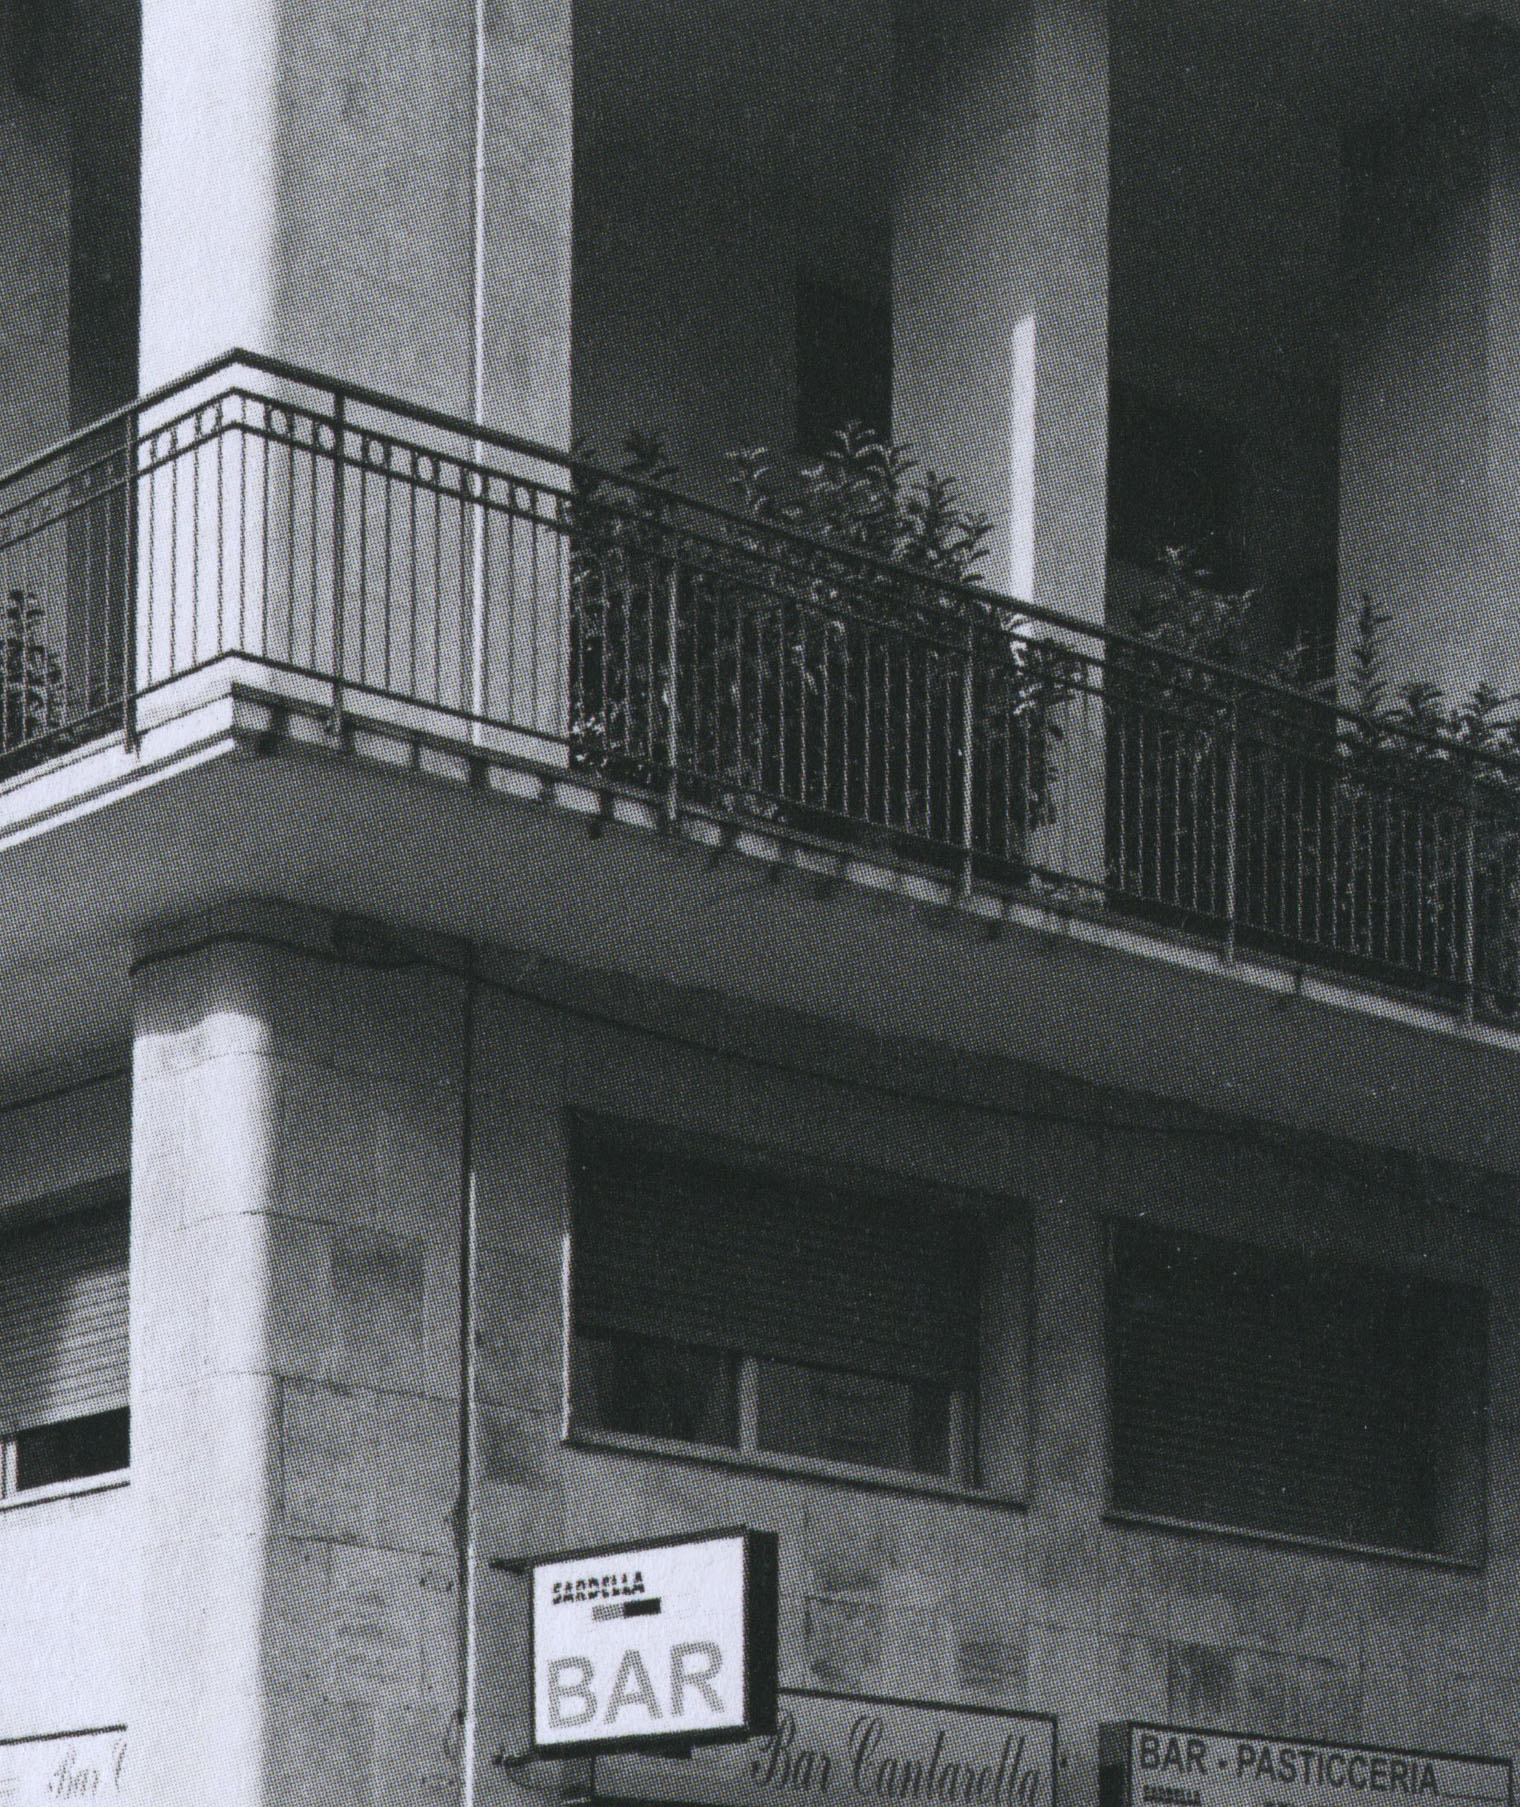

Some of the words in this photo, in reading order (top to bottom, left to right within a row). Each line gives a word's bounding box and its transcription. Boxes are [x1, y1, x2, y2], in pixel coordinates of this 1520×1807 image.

[547, 1641, 725, 1730] BAR
[751, 1708, 831, 1794] Bar
[1139, 1734, 1208, 1775] BAR
[1236, 1744, 1440, 1797] PASTICCERIA
